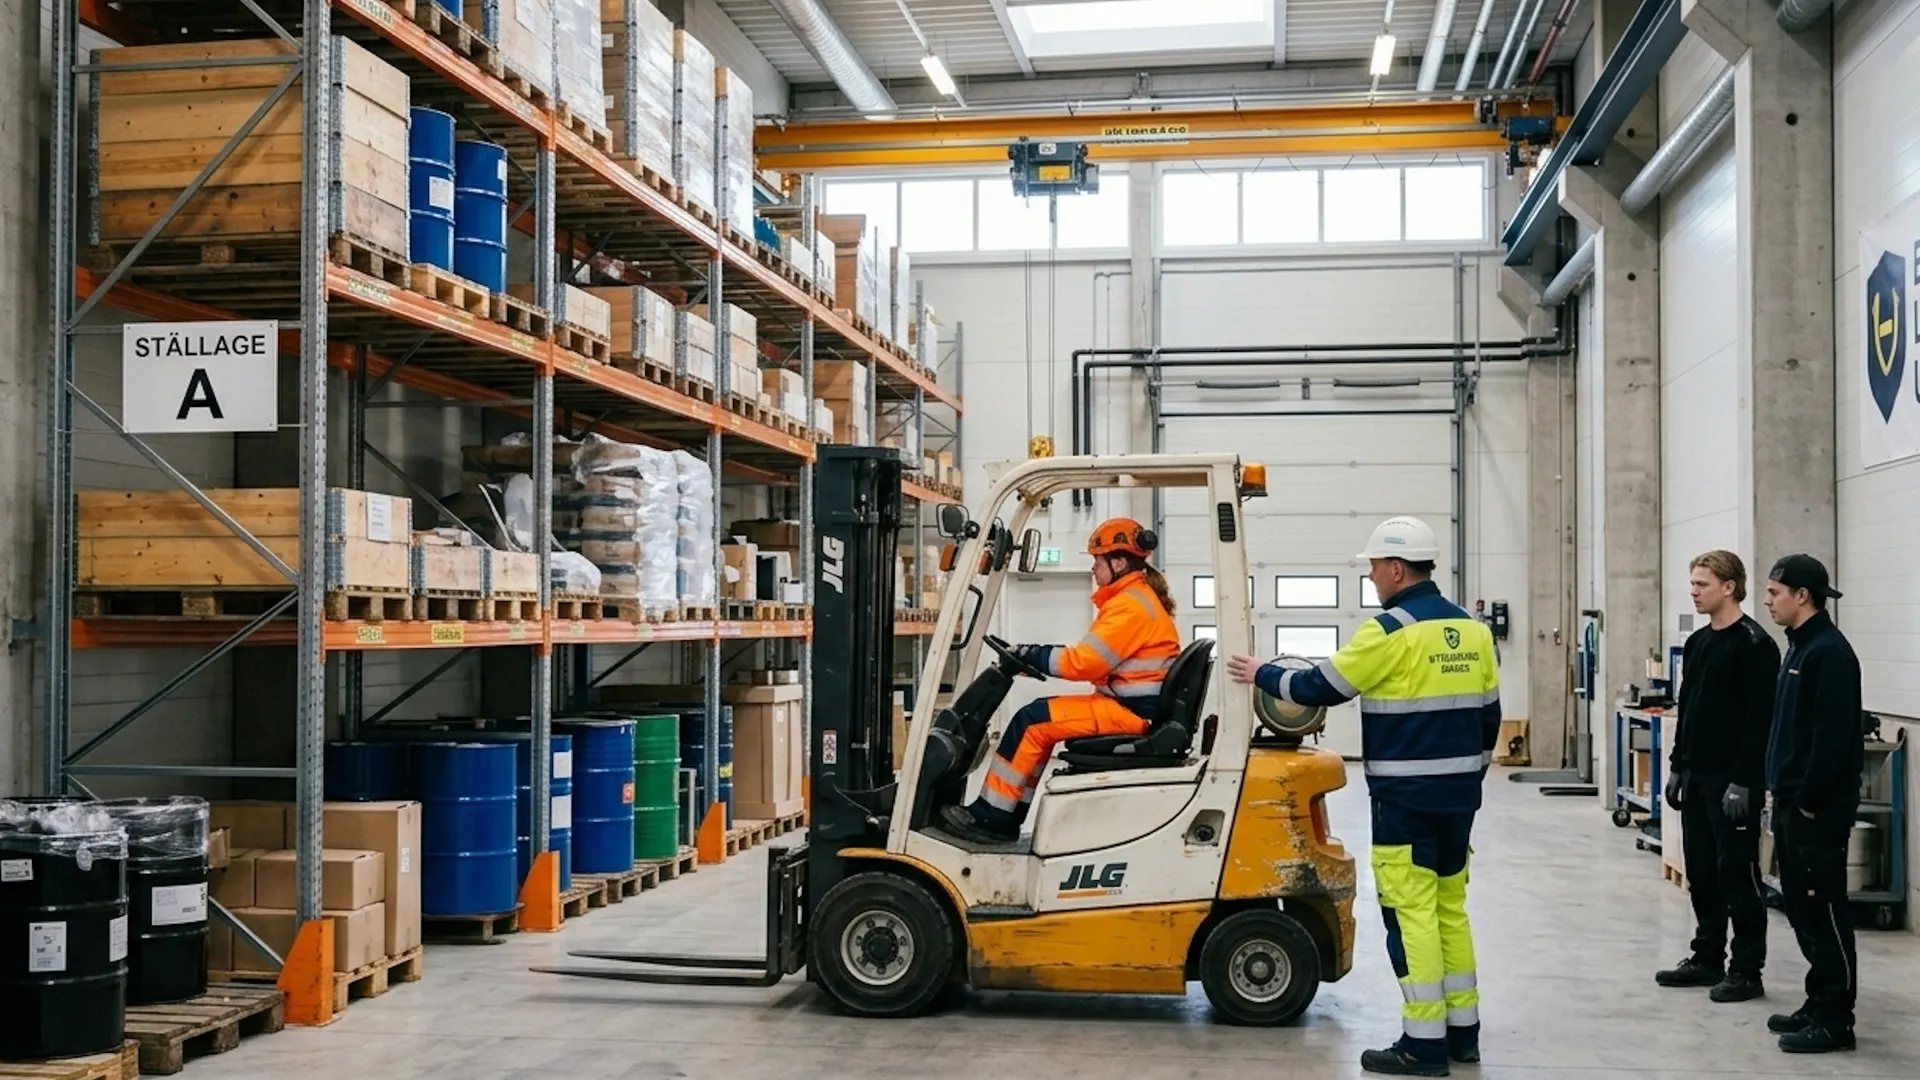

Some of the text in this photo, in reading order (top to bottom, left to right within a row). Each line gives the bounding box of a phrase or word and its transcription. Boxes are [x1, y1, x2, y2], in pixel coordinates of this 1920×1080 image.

[135, 332, 266, 358] STÄLLAGE
[176, 368, 224, 420] A
[822, 535, 844, 593] JLG
[1059, 862, 1127, 890] JLG
